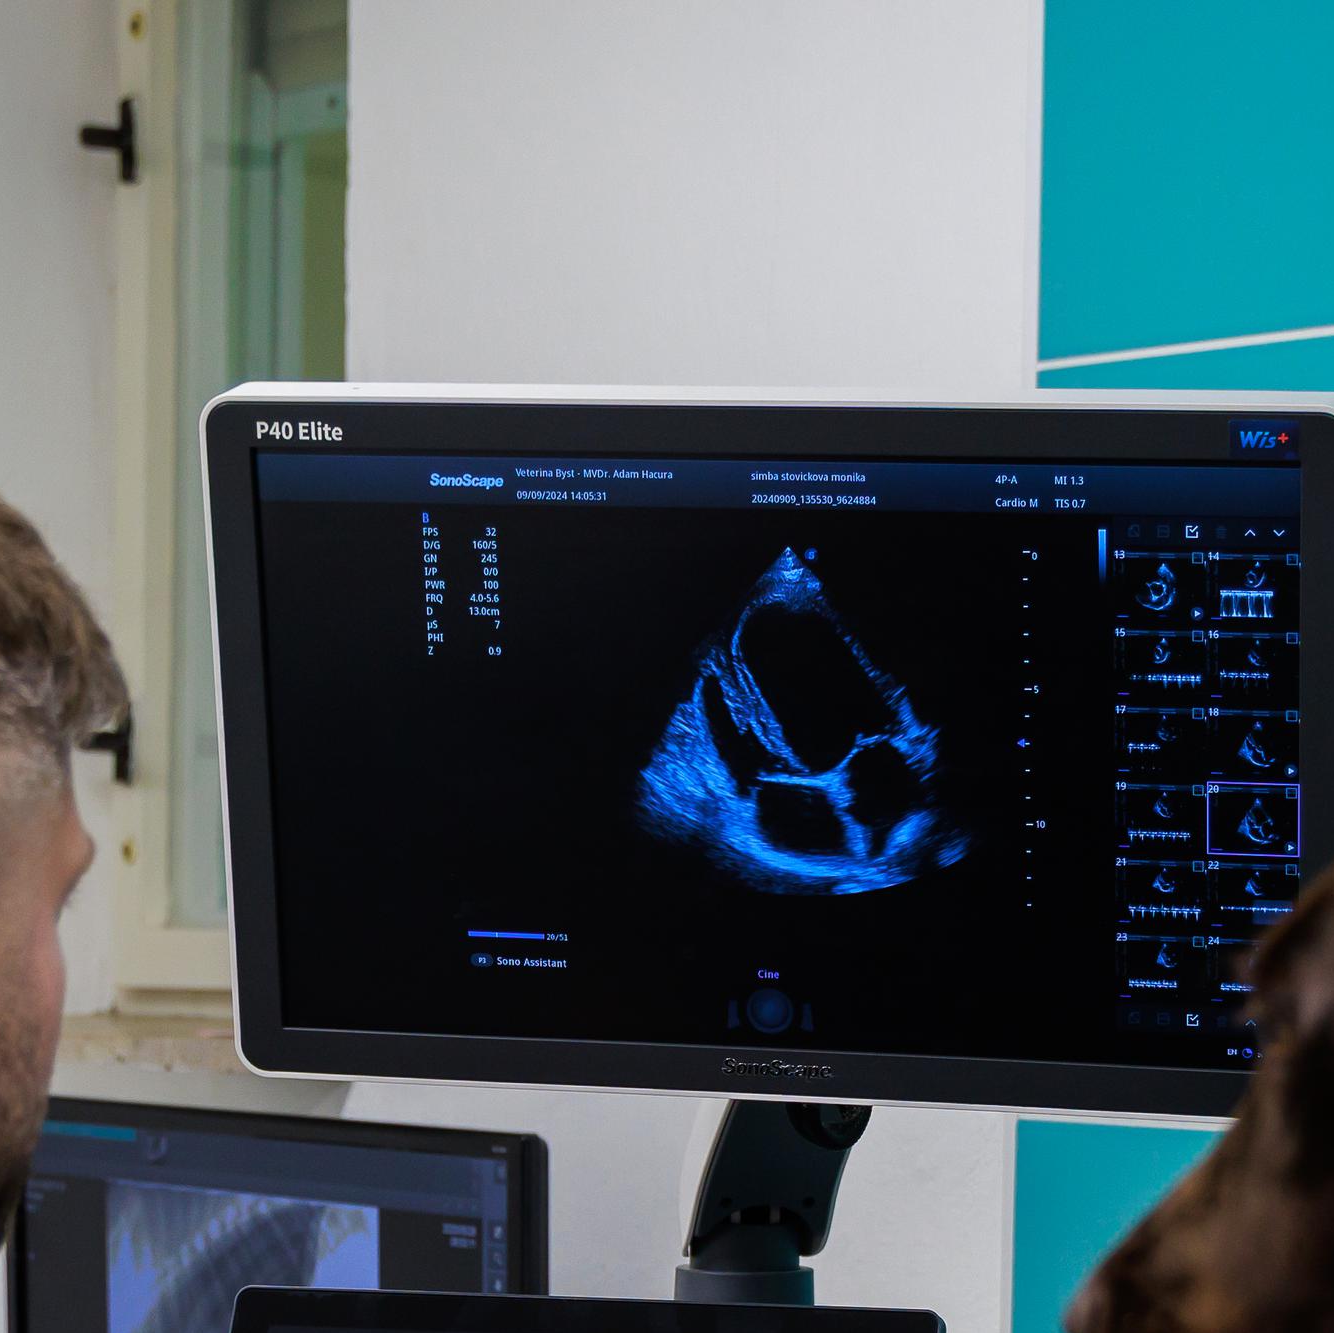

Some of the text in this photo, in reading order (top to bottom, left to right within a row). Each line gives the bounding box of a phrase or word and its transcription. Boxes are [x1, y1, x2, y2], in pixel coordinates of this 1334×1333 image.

[256, 421, 343, 442] P40 Elite
[515, 468, 554, 478] Veterina
[555, 468, 575, 481] Byst
[583, 468, 611, 479] MVDr.
[613, 468, 639, 479] Adam
[641, 469, 673, 480] Hacura
[750, 471, 866, 483] simba stovickova monika
[429, 472, 505, 490] SonoScape
[995, 475, 1018, 485] 4P-A
[1054, 475, 1084, 486] MI 1.3
[516, 490, 607, 501] 09/09/2024 14:05:31
[995, 497, 1039, 508] Cardio M
[1054, 498, 1086, 509] TIS 0.7
[422, 512, 430, 524] B
[422, 527, 497, 537] FPS 32
[423, 540, 497, 550] D/G 160/5
[423, 553, 498, 563] GN 245
[1114, 550, 1126, 559] 13
[1208, 552, 1220, 561] 14
[424, 567, 499, 576] I/P 0/0
[425, 580, 499, 590] PWR 100
[425, 593, 500, 604] FRQ 4.0-5.6
[426, 606, 500, 616] D 13.0cm
[494, 620, 501, 630] 7
[1114, 628, 1126, 637] 15
[1208, 630, 1220, 639] 16
[427, 633, 444, 643] PHI
[428, 646, 502, 656] Z 0.9
[1033, 685, 1039, 694] 5
[1115, 705, 1127, 714] 17
[1208, 708, 1220, 717] 18
[1115, 782, 1127, 791] 19
[1208, 785, 1220, 793] 20
[1035, 820, 1046, 829] 10
[1115, 858, 1127, 866] 21
[1208, 861, 1220, 870] 22
[1116, 933, 1128, 941] 23
[1208, 936, 1220, 945] 24
[496, 956, 521, 966] Sono
[523, 957, 567, 969] Assistant
[757, 969, 780, 979] Cine
